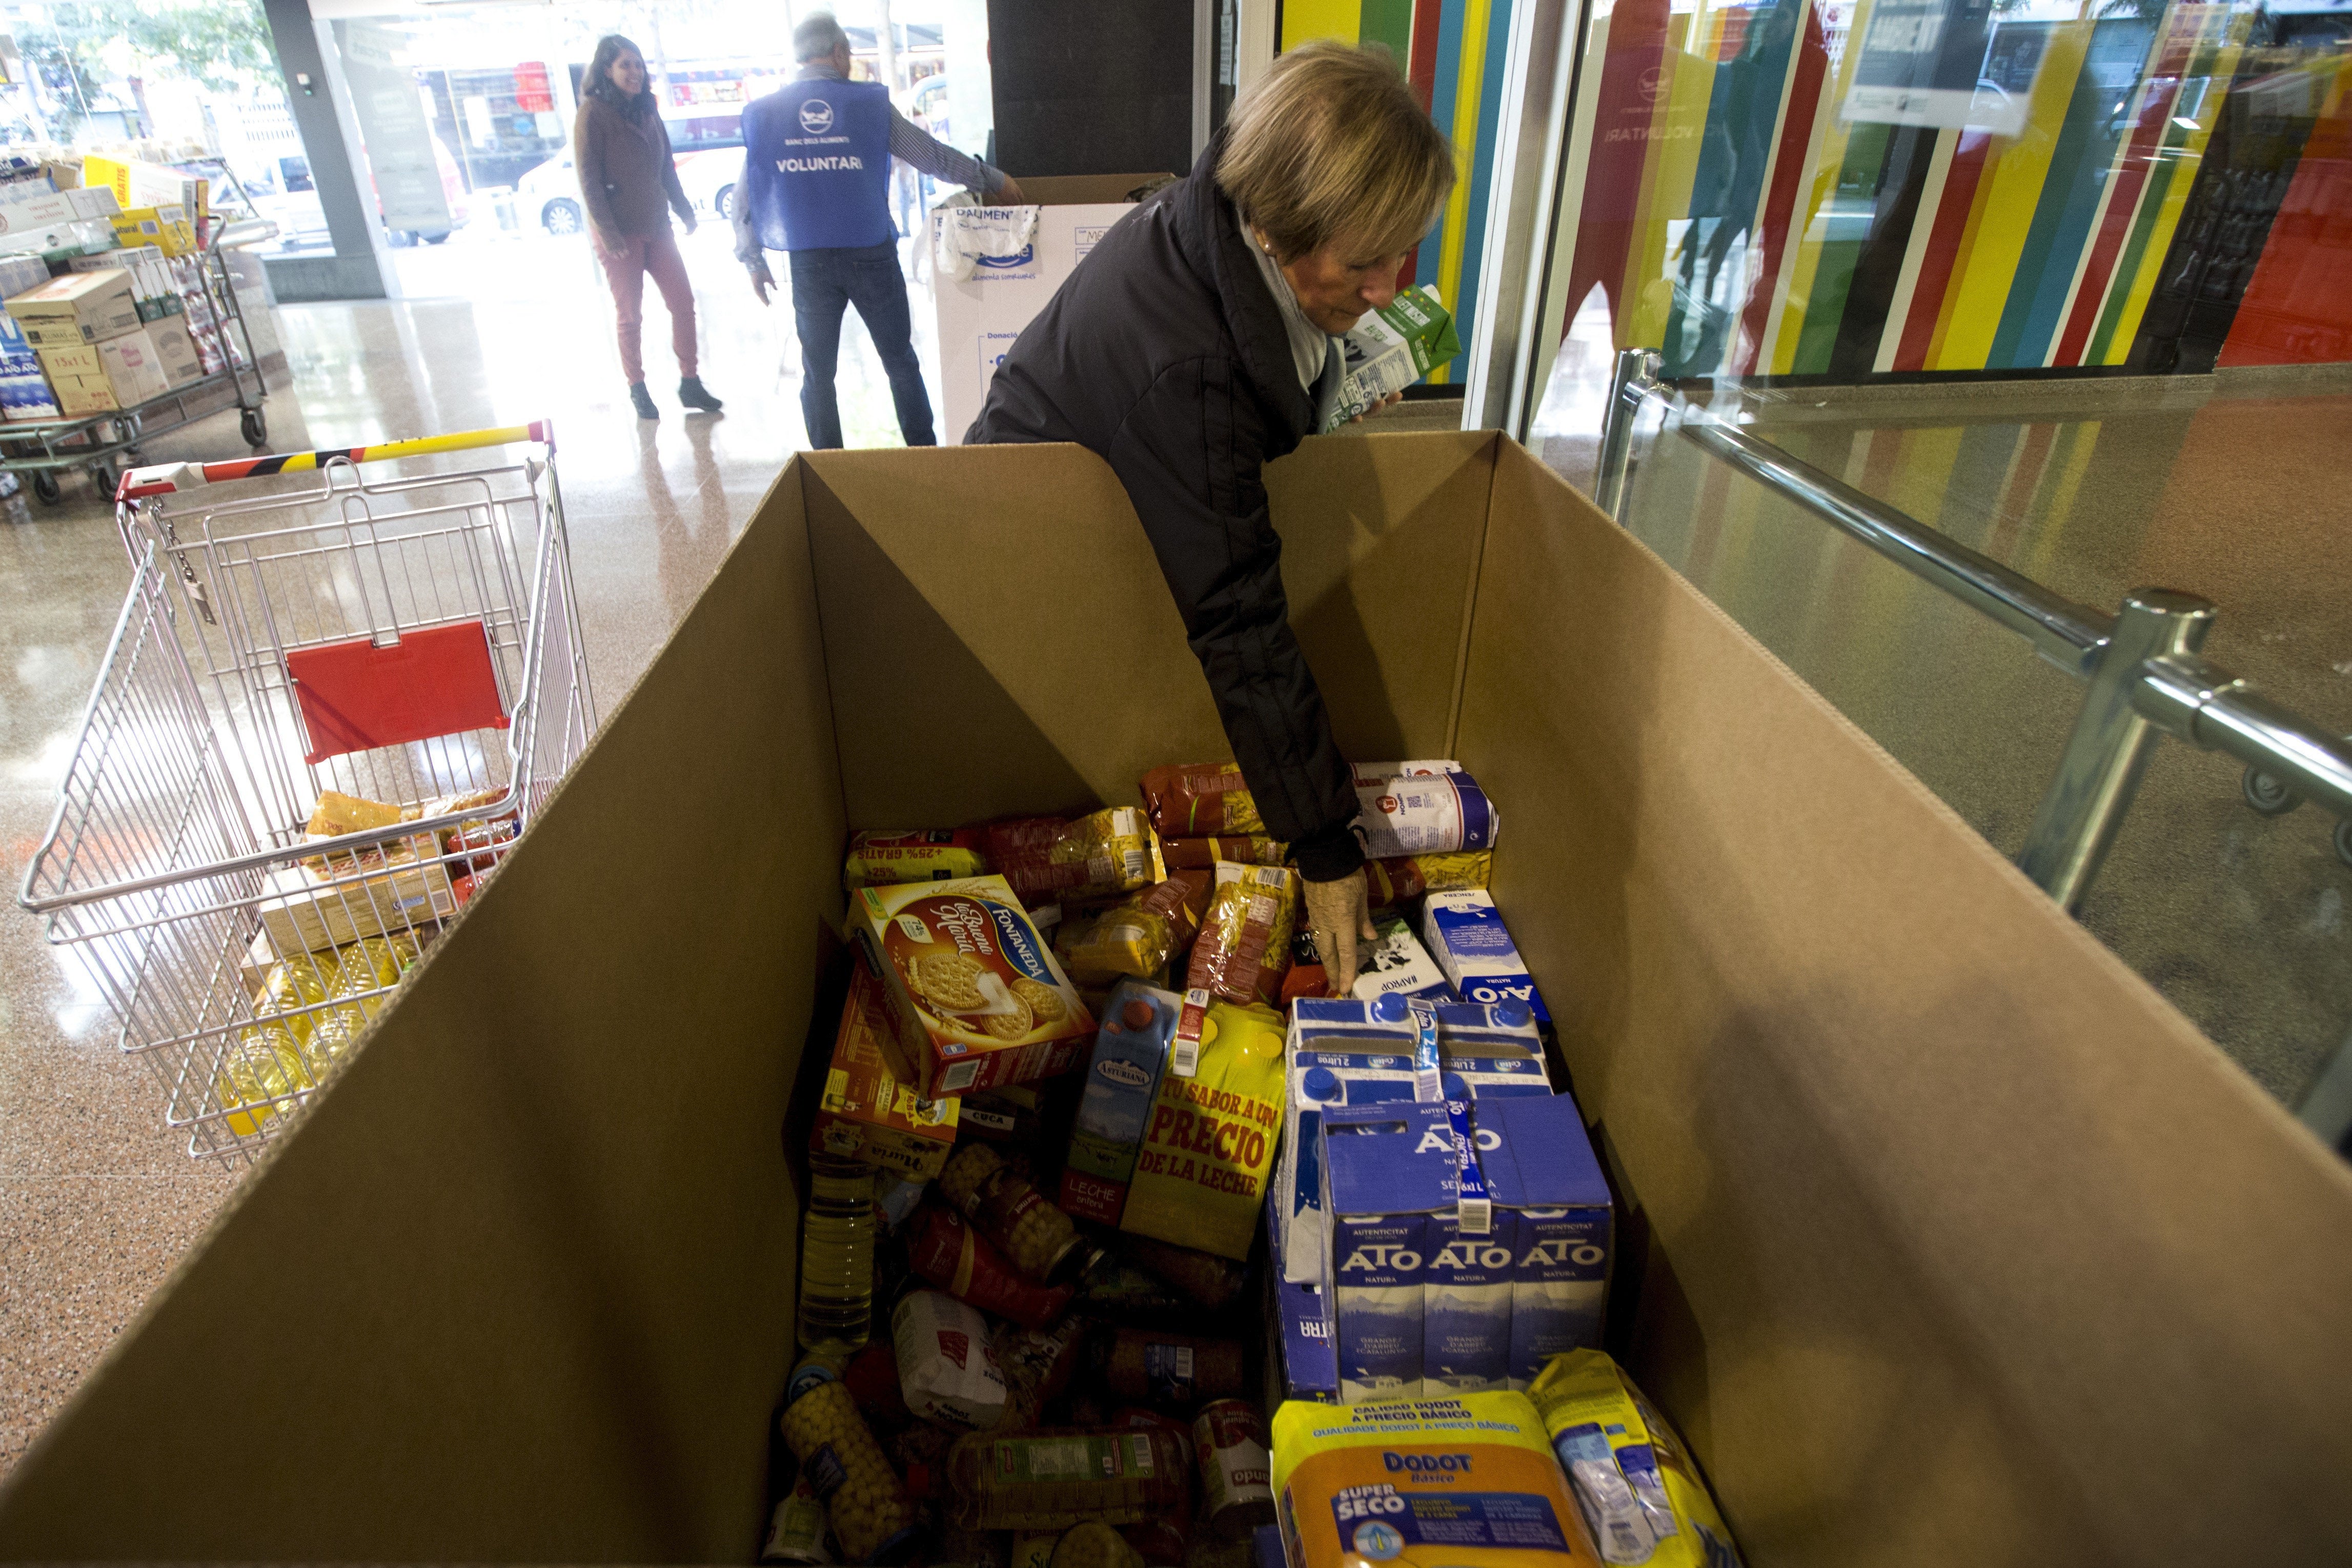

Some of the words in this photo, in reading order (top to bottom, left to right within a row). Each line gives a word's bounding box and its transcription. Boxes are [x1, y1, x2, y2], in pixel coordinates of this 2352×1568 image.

[776, 155, 863, 173] VOLUNTARI
[116, 168, 126, 203] GRATIS
[857, 848, 902, 860] GRATIS
[963, 909, 992, 956] Buena
[992, 908, 1045, 979] FONTANEDA
[1317, 1054, 1342, 1066] Litros
[1344, 1056, 1350, 1066] 2
[1443, 1059, 1467, 1070] Litros
[1469, 1060, 1475, 1070] 2
[1101, 1062, 1147, 1085] ASTURIANA
[1162, 1077, 1184, 1100] TU
[1186, 1083, 1239, 1116] SABOR
[1242, 1099, 1255, 1118] A
[1257, 1102, 1278, 1129] UN
[1450, 1100, 1466, 1116] ATO
[972, 1111, 1004, 1124] CUCA
[1148, 1105, 1266, 1169] PRECIO
[871, 1146, 923, 1171] Nuria
[1138, 1149, 1165, 1175] DE
[1166, 1153, 1194, 1182] LA
[1198, 1164, 1259, 1197] LECHE
[1069, 1178, 1116, 1203] LECHE
[1353, 1228, 1409, 1236] AUTENTICITAT
[1341, 1244, 1423, 1272] ATO
[1428, 1240, 1512, 1270] ATO
[1518, 1238, 1605, 1267] ATO
[1353, 1401, 1410, 1414] CALIDAD
[1414, 1399, 1462, 1410] DODOT
[1364, 1412, 1417, 1422] PRECIO
[1312, 1423, 1377, 1438] QUALIDADE
[1380, 1423, 1421, 1433] DODOT
[1423, 1422, 1432, 1430] A
[1337, 1483, 1396, 1501] SUPER
[1337, 1495, 1406, 1521] SECO
